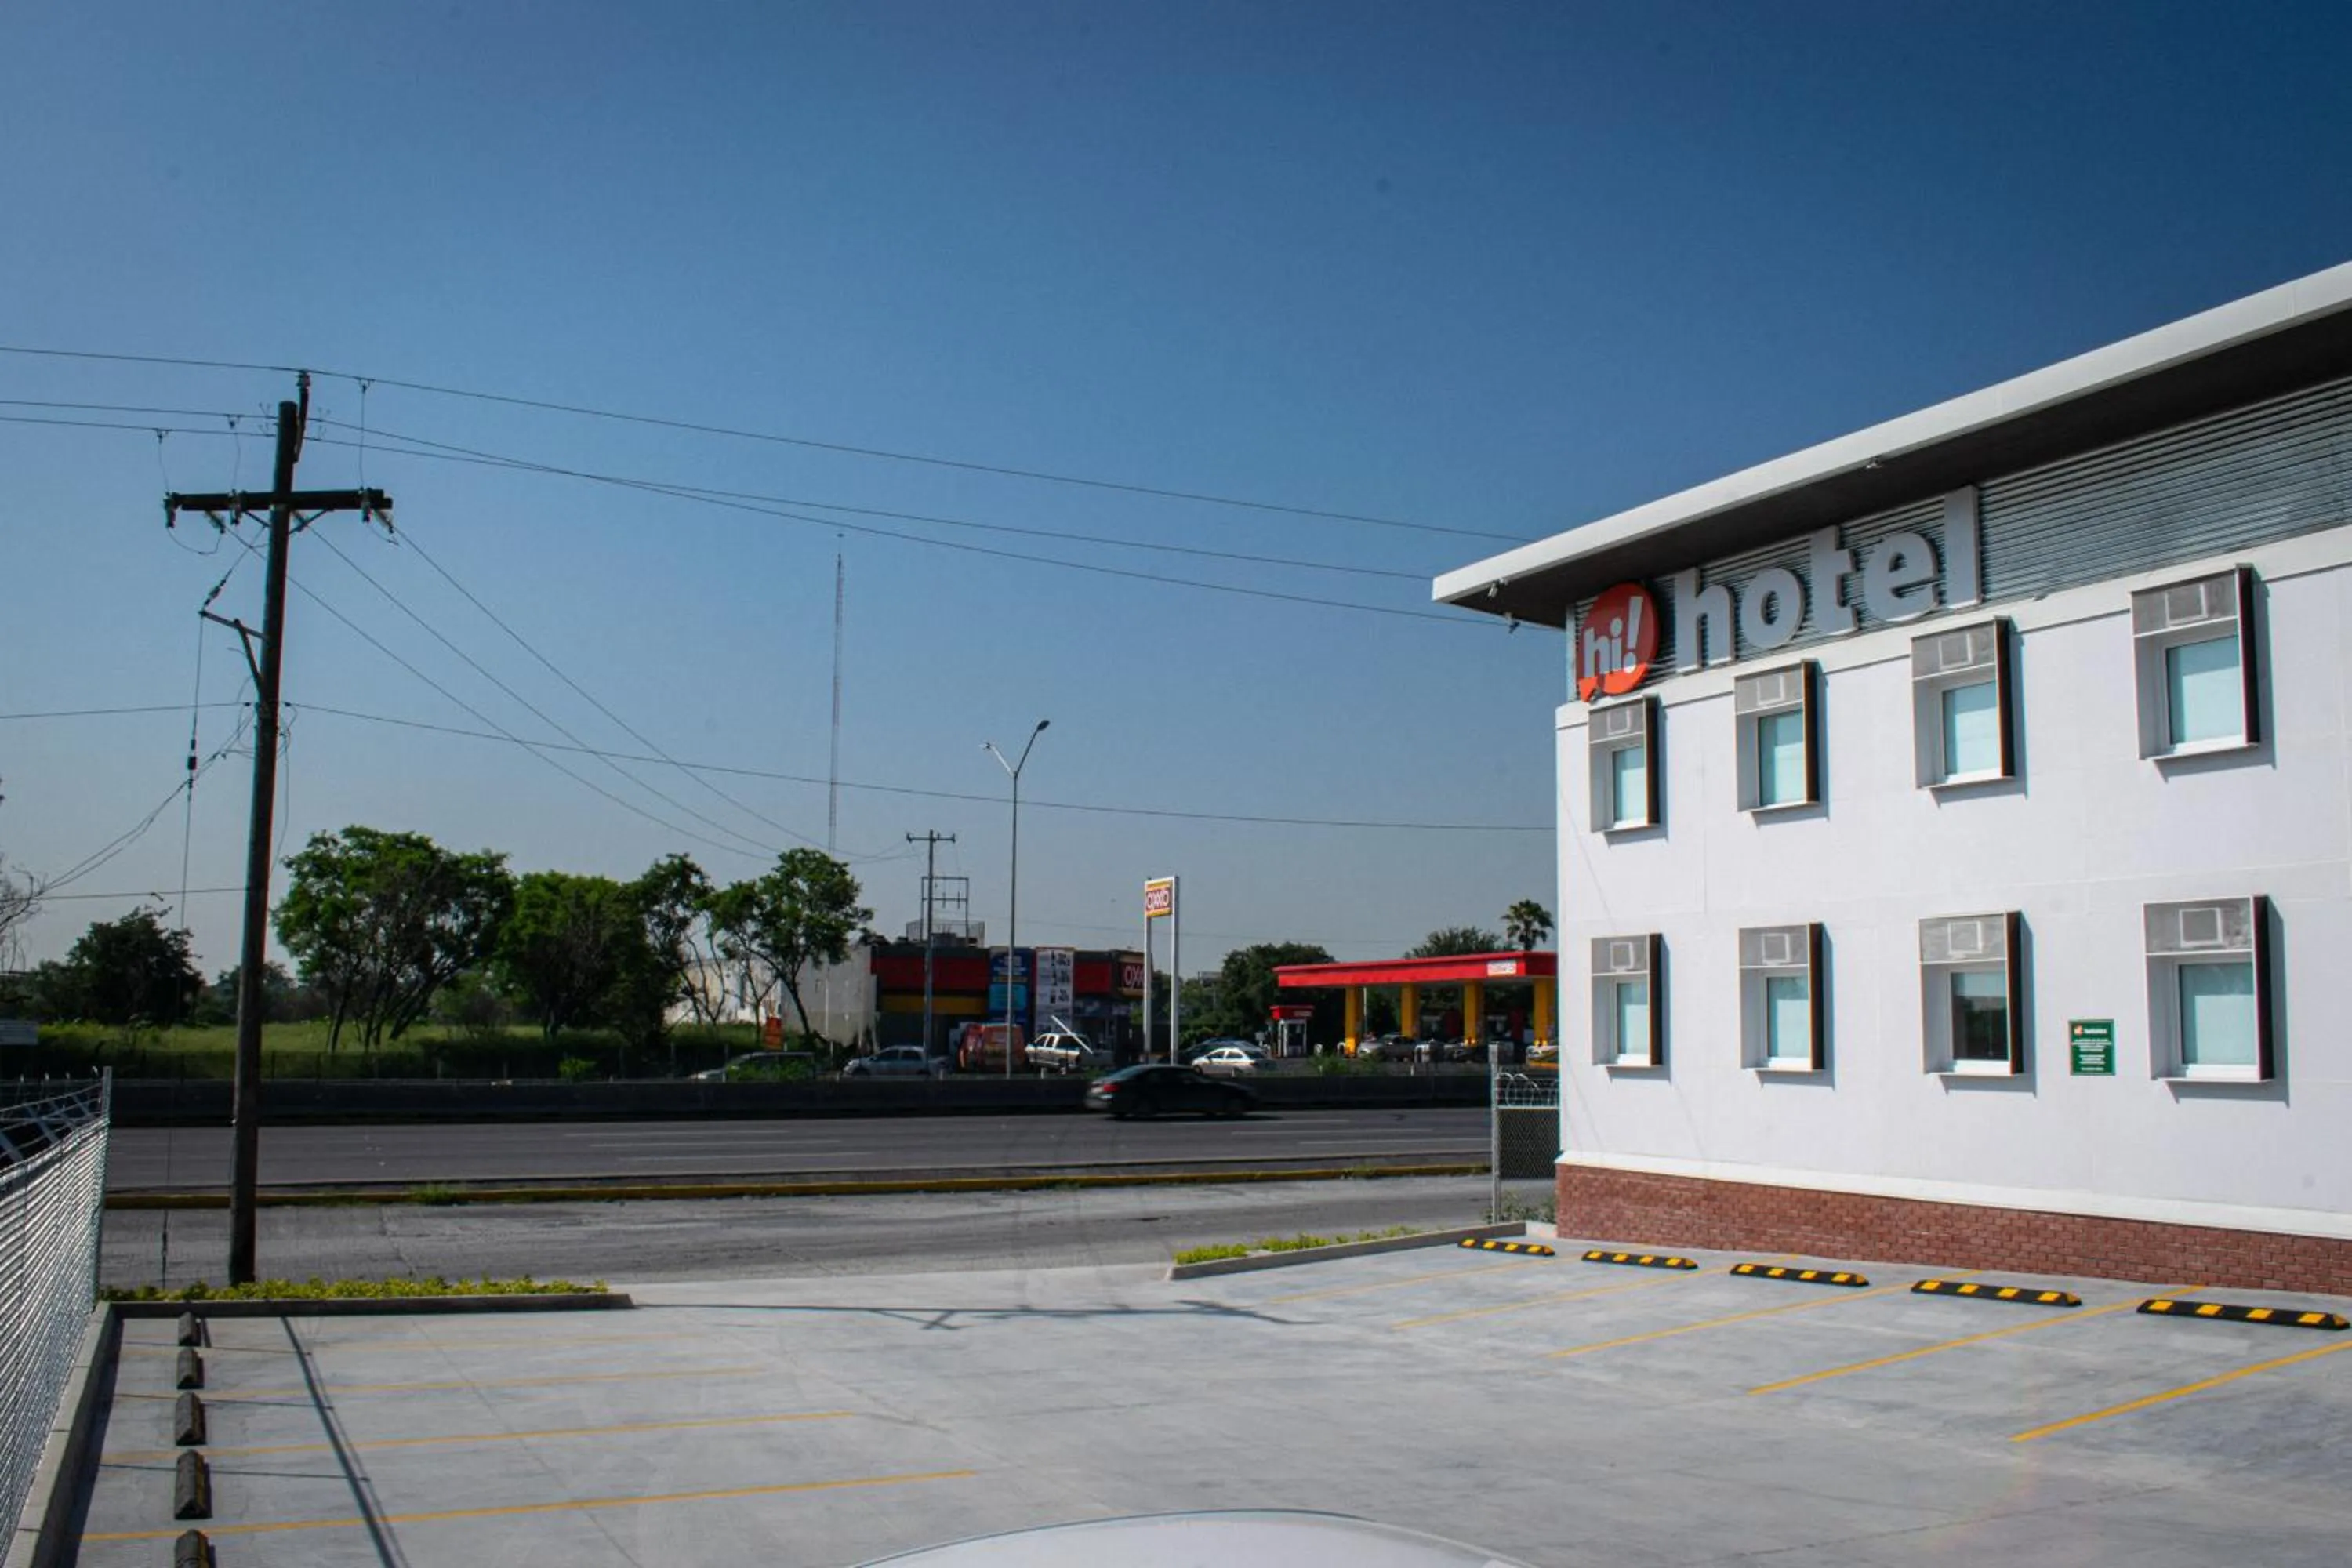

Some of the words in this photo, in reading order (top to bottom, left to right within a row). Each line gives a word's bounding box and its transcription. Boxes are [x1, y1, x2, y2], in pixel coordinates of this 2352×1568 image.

[1584, 596, 1643, 678] hi!
[1675, 485, 1981, 673] hotel
[1147, 890, 1169, 910] OXXO
